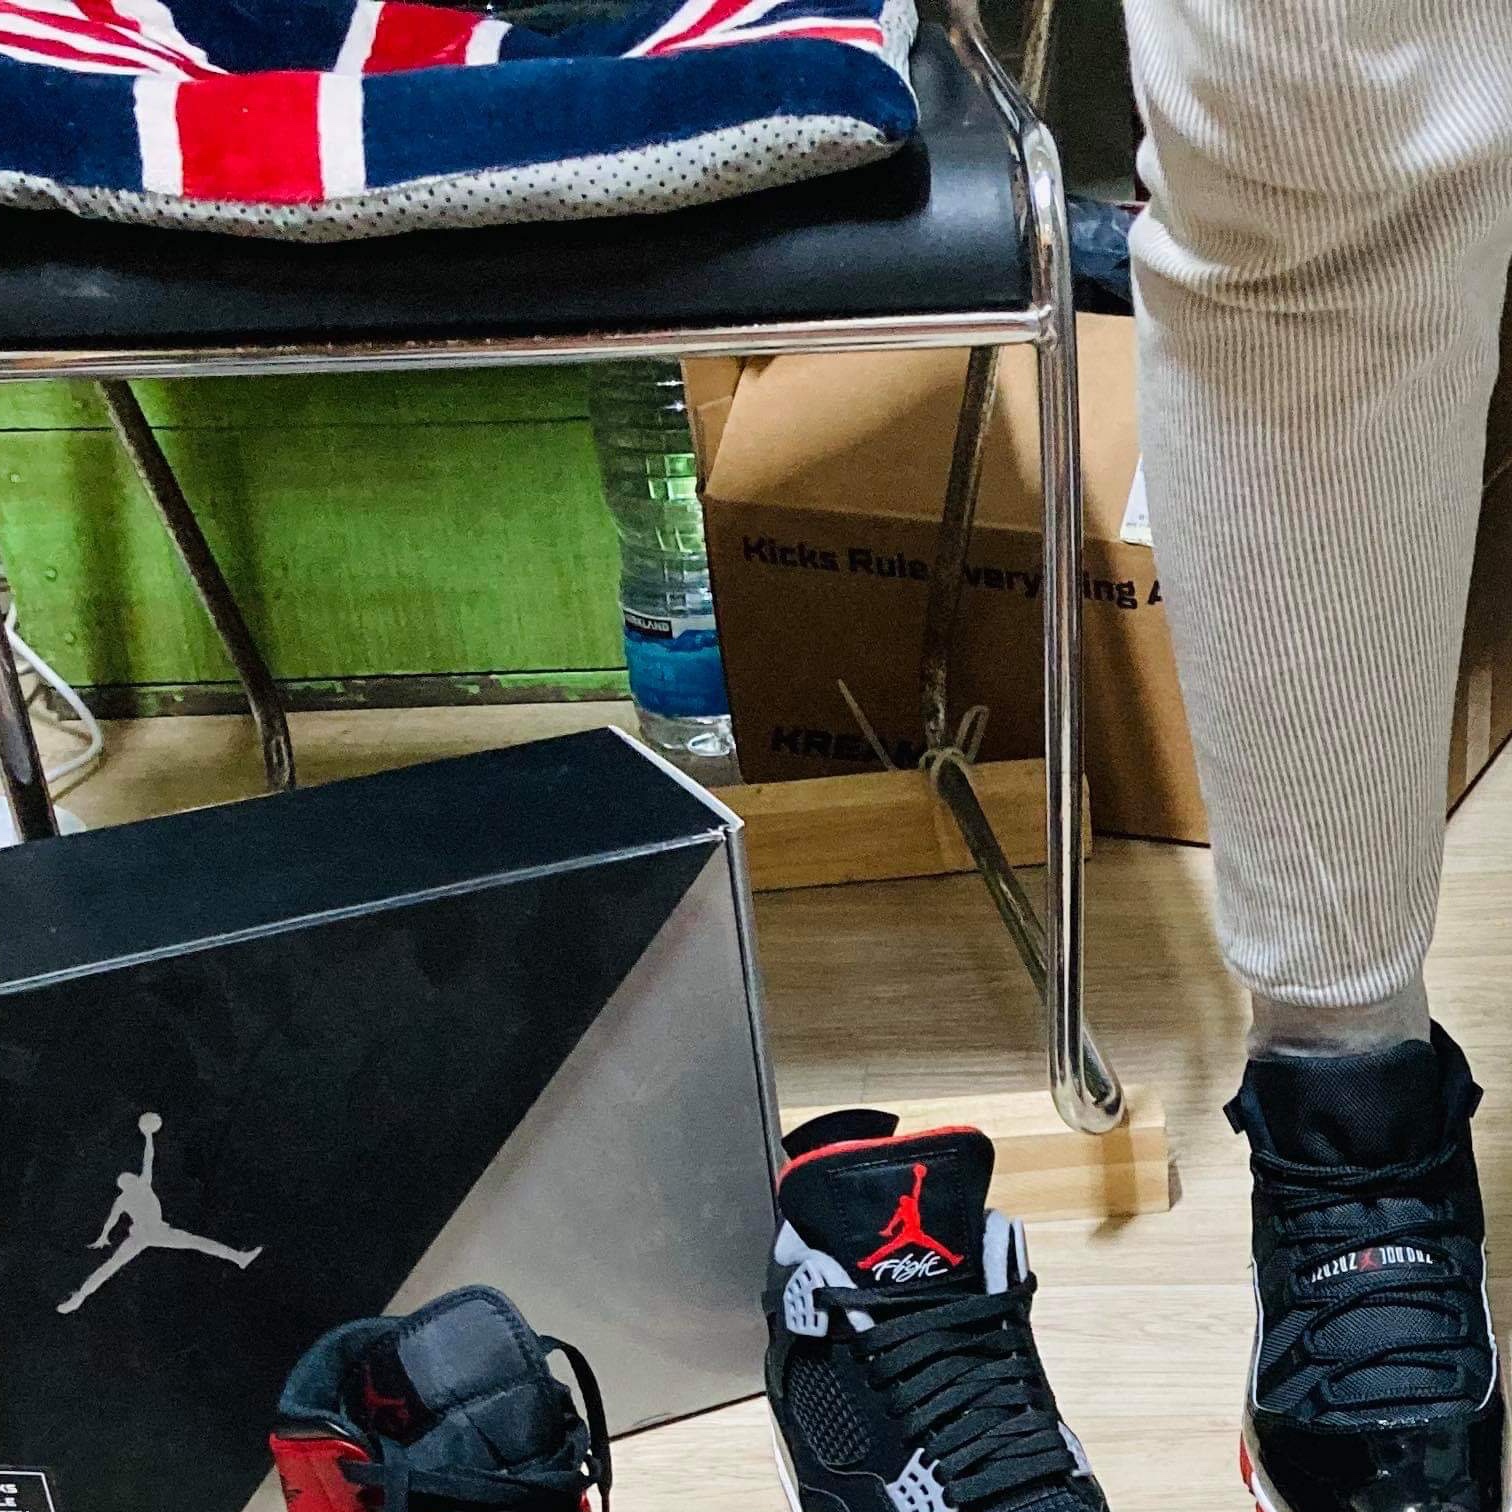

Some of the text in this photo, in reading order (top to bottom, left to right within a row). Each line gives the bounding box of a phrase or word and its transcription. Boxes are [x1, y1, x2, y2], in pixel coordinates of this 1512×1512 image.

[742, 535, 840, 572] Kicks
[847, 547, 931, 580] Rule
[960, 562, 1138, 610] verying
[872, 1250, 949, 1283] Flight
